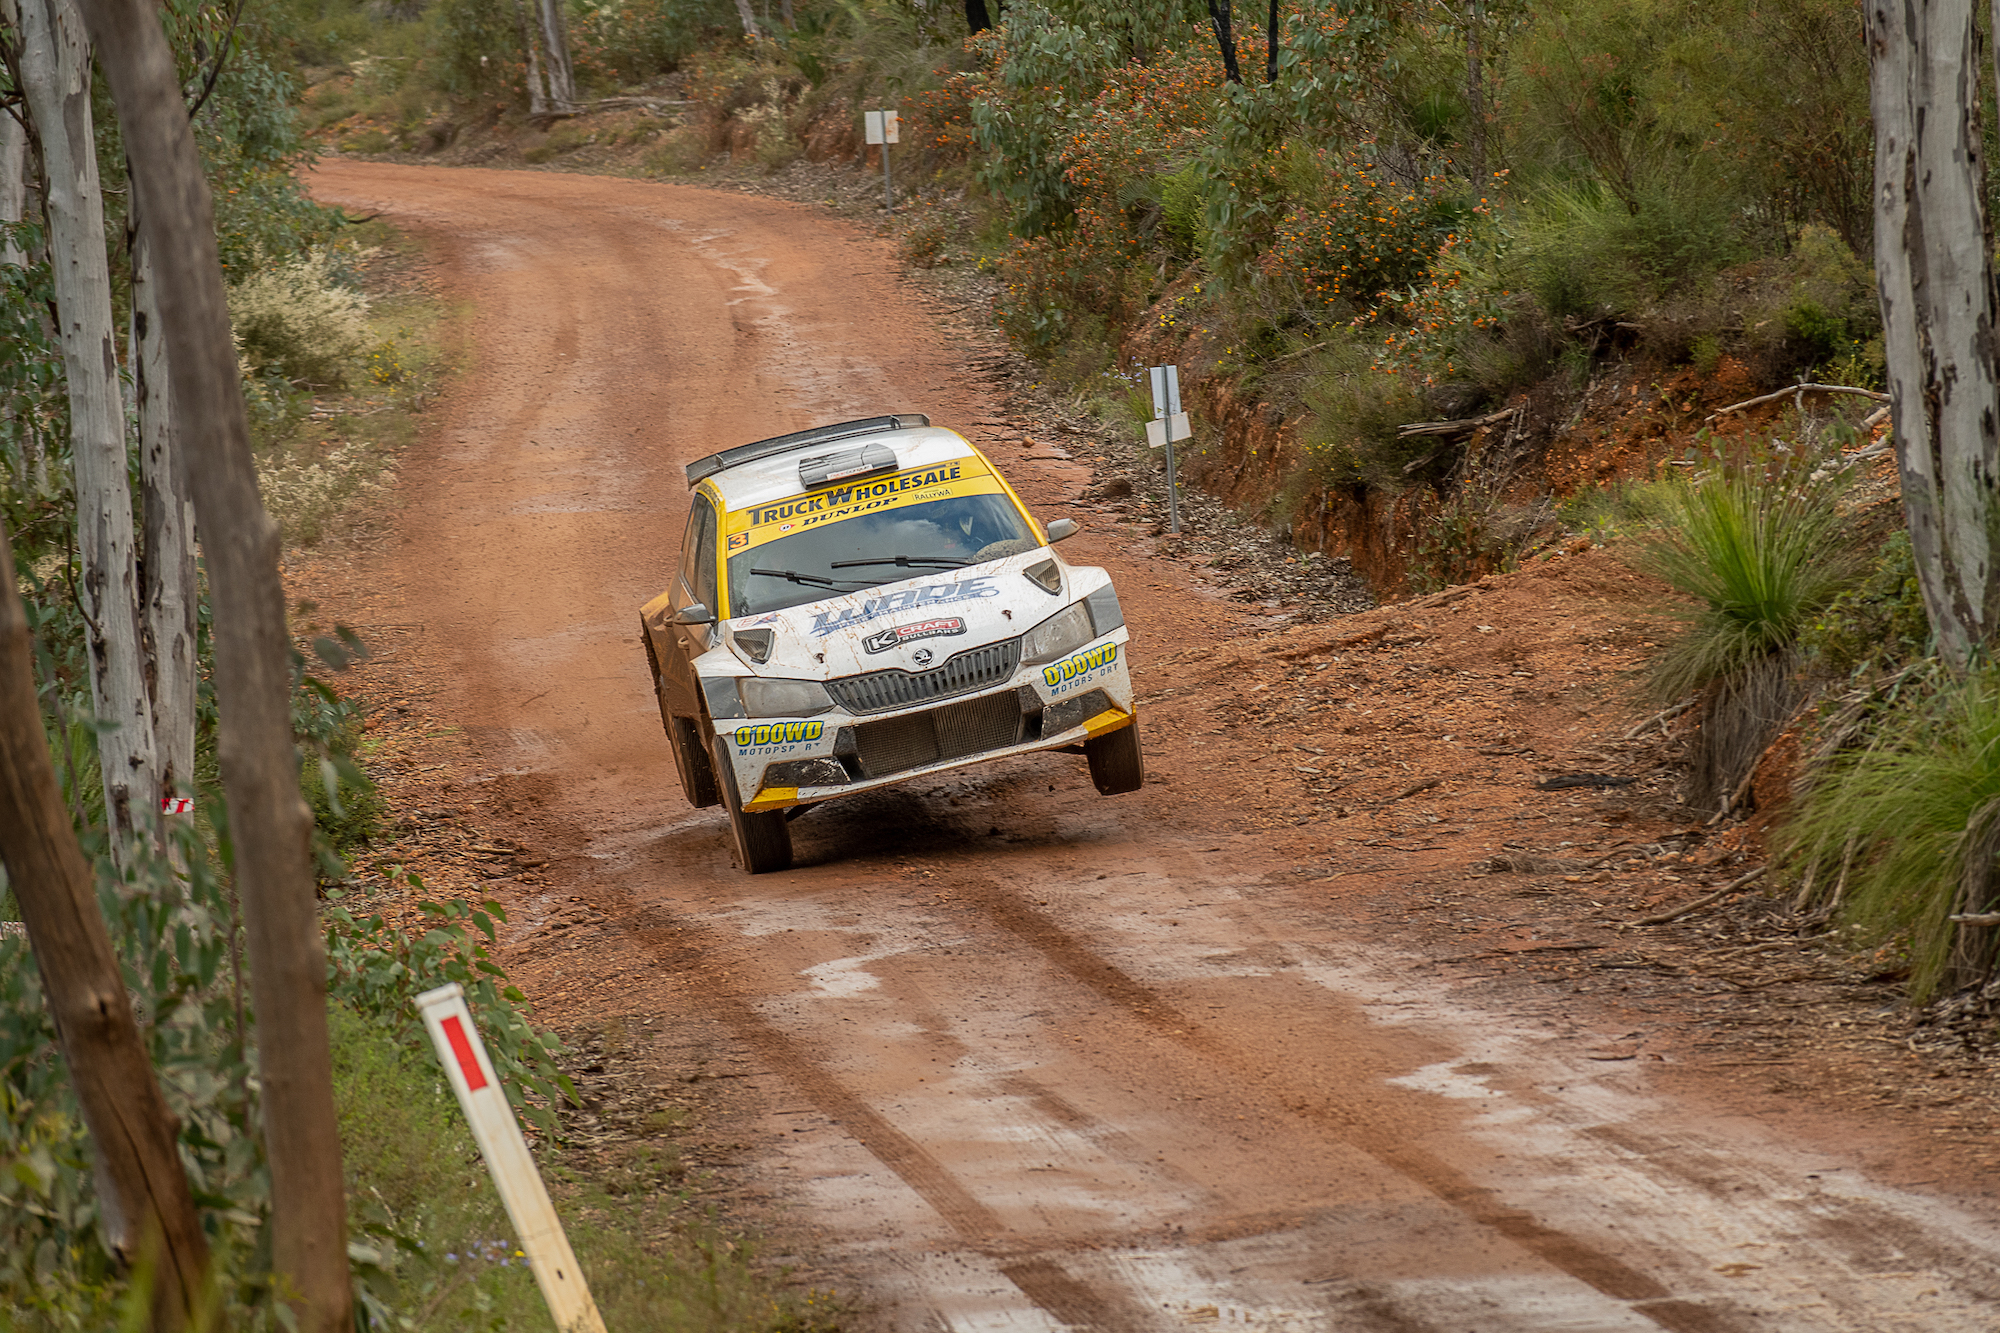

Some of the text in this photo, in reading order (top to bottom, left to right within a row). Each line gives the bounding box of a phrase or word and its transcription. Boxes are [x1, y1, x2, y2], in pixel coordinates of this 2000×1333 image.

[802, 497, 898, 527] DUNLOP
[730, 533, 748, 549] 3
[810, 576, 998, 629] WADE
[871, 620, 955, 649] K CRAFT
[901, 628, 959, 641] BULLBARS
[1042, 641, 1117, 688] O'DOWD
[735, 721, 824, 747] O'DOWD
